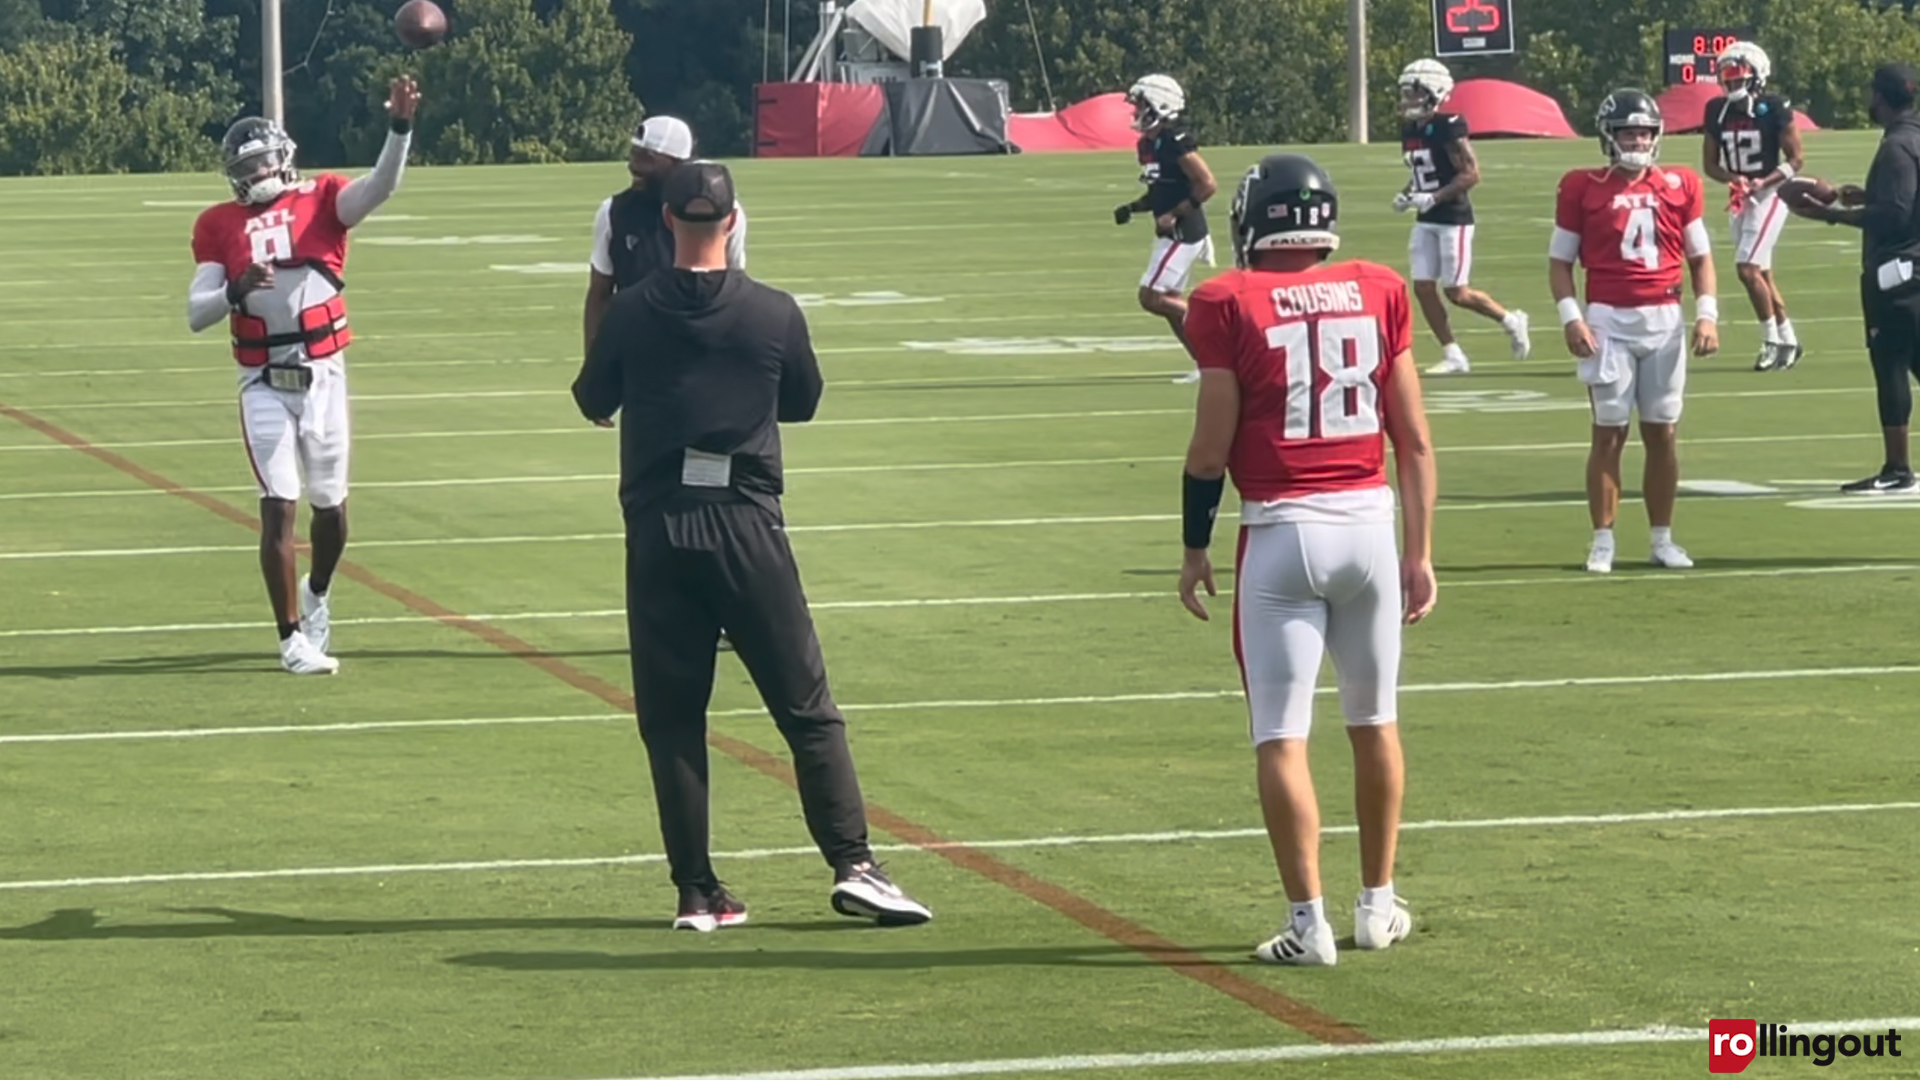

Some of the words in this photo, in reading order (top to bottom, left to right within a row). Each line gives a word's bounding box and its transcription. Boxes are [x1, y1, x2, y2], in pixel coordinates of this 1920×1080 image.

[1682, 65, 1694, 83] 0
[1721, 130, 1762, 172] 12
[1612, 192, 1660, 209] ATL
[244, 209, 296, 235] ATL
[1620, 208, 1659, 269] 4
[1271, 281, 1363, 317] COUSINS
[1265, 316, 1381, 440] 18
